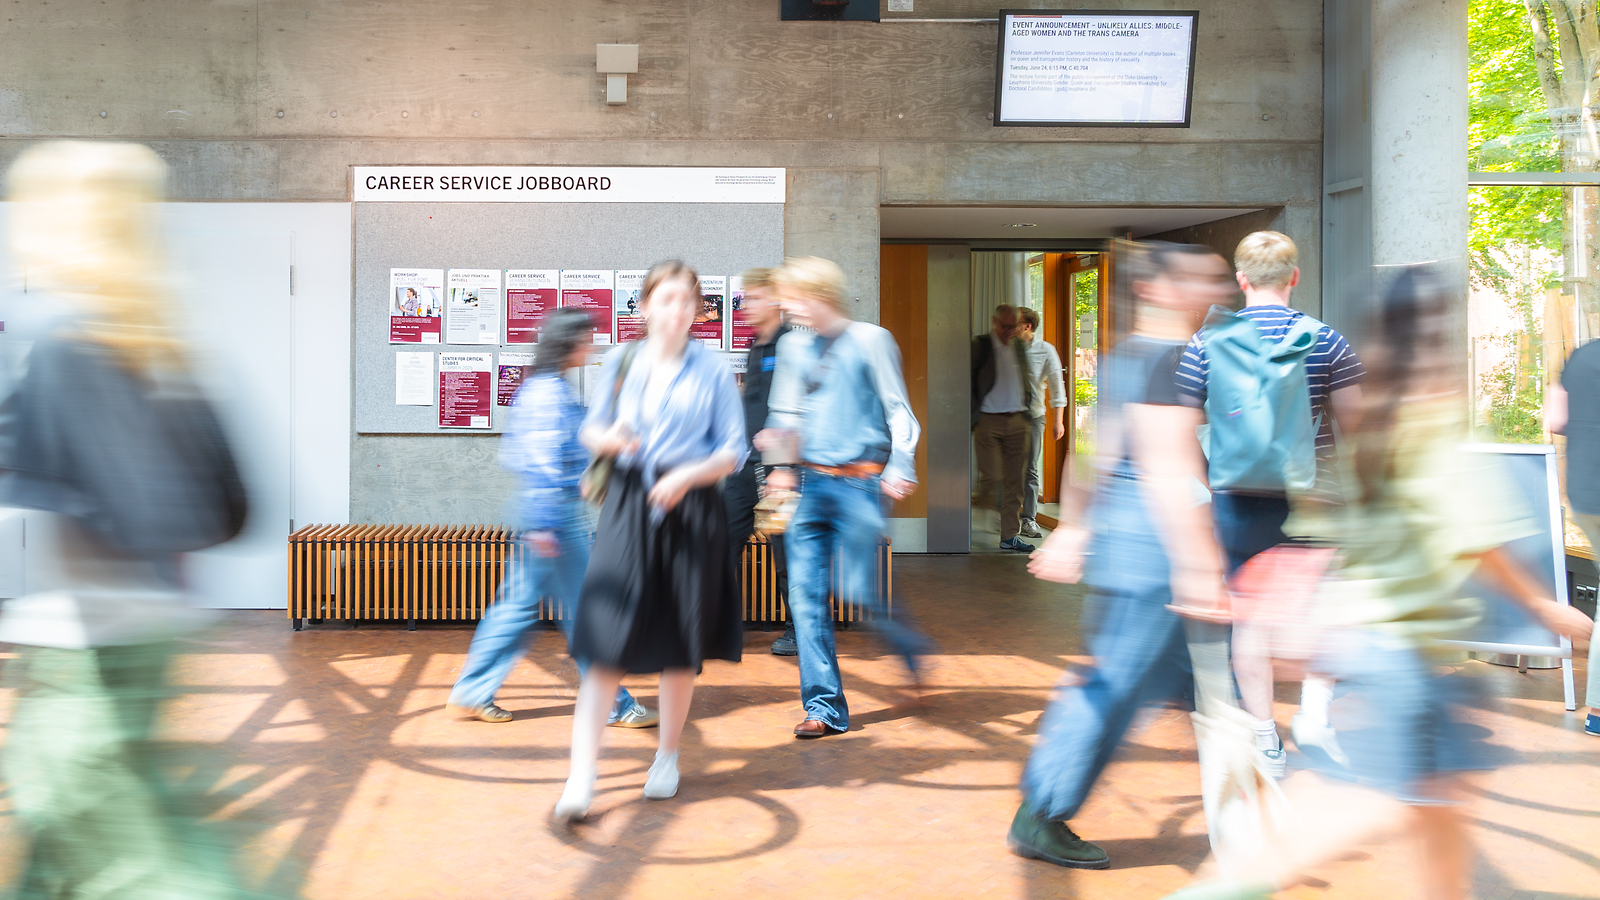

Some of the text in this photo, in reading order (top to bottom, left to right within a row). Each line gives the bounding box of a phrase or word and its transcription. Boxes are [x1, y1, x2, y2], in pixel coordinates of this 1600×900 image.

[366, 175, 612, 190] CAREER SERVICE JOBBOARD
